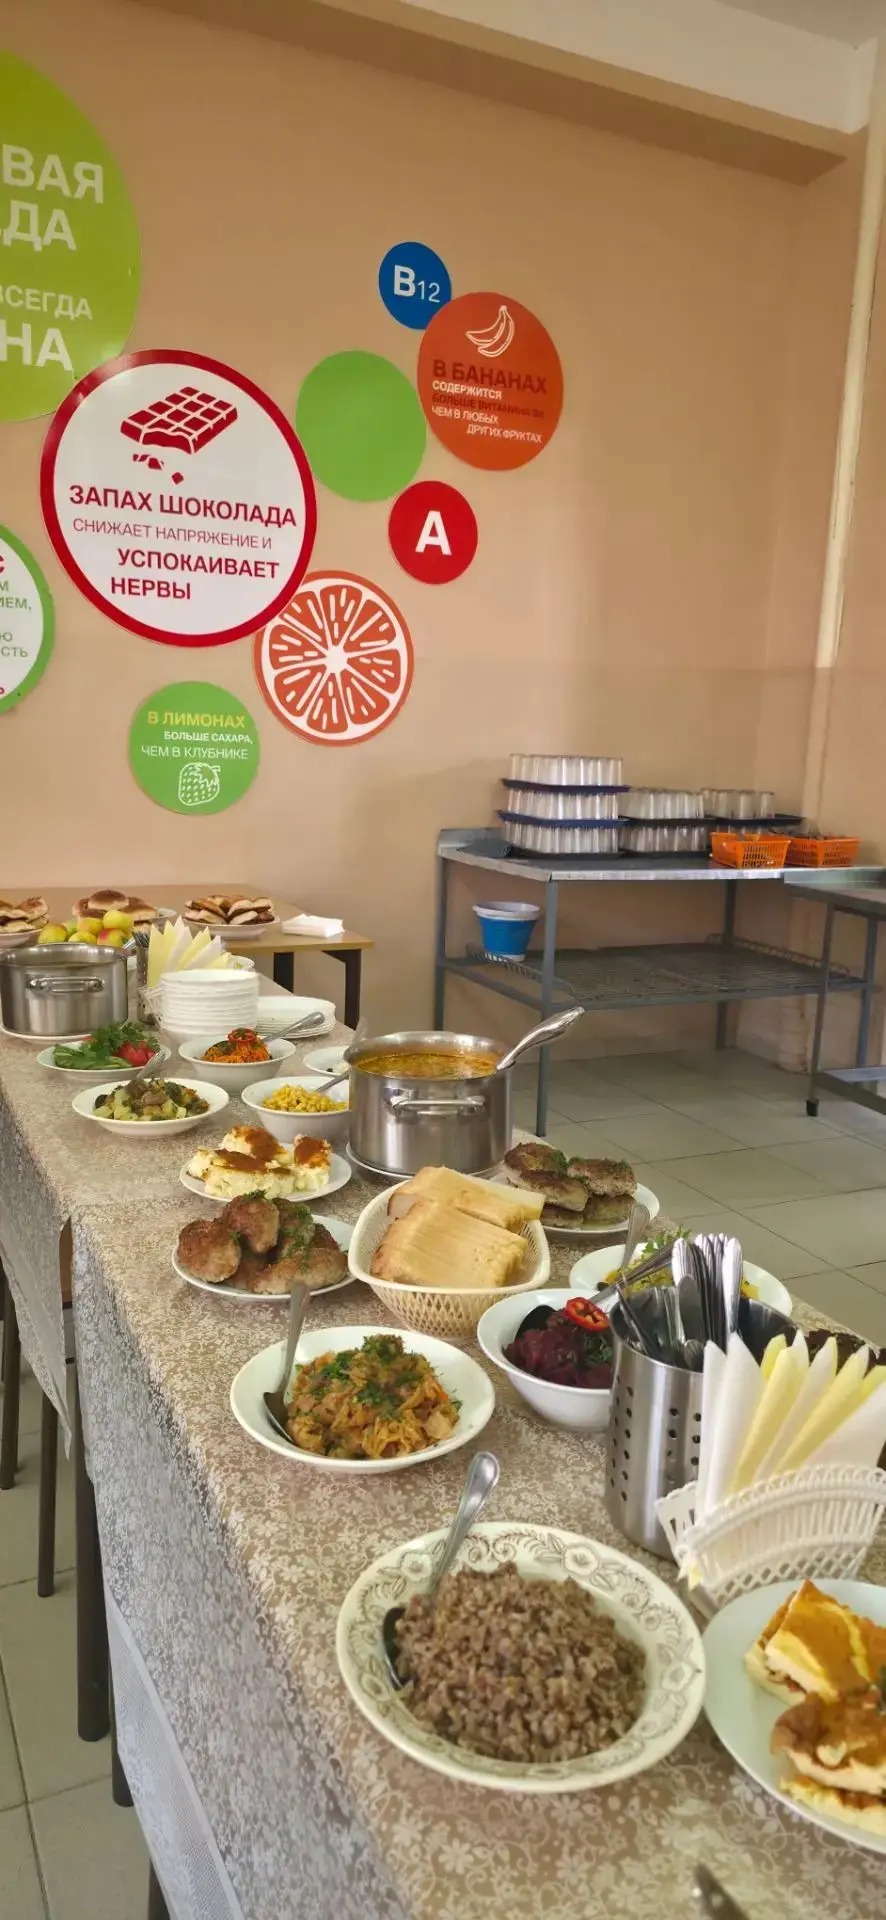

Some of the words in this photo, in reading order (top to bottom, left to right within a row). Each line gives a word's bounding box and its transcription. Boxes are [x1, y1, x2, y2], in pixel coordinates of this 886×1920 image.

[2, 144, 104, 204] ВАЯ
[0, 199, 77, 252] ДА
[433, 359, 446, 377] В
[452, 362, 547, 395] БАНАНАХ
[432, 380, 502, 400] СОДЕРЖИТСЯ
[431, 406, 452, 417] ЧЕМ
[454, 409, 461, 419] В
[462, 410, 499, 425] ЛЮБЫХ
[432, 393, 476, 408] БОЛЬШЕ
[478, 400, 530, 416] ВИТАМИНА
[467, 424, 501, 437] ДРУГИХ
[502, 429, 543, 444] ФРУКТАХ
[69, 484, 152, 512] ЗАПАХ
[159, 494, 297, 528] ШОКОЛАДА
[73, 518, 151, 538] СНИЖАЕТ
[156, 527, 261, 548] НАПРЯЖЕНИЕ
[262, 537, 272, 549] И
[415, 510, 452, 556] A
[117, 548, 280, 579] УСПОКАИВАЕТ
[111, 577, 191, 600] НЕРВЫ
[1, 646, 28, 657] СТЬ
[148, 711, 158, 724] В
[162, 712, 245, 728] ЛИМОНАХ
[164, 731, 209, 741] БОЛЬШЕ
[211, 733, 253, 744] САХАРА,
[142, 745, 169, 757] ЧЕМ
[172, 746, 181, 758] В
[184, 747, 248, 759] КЛУБНИКЕ
